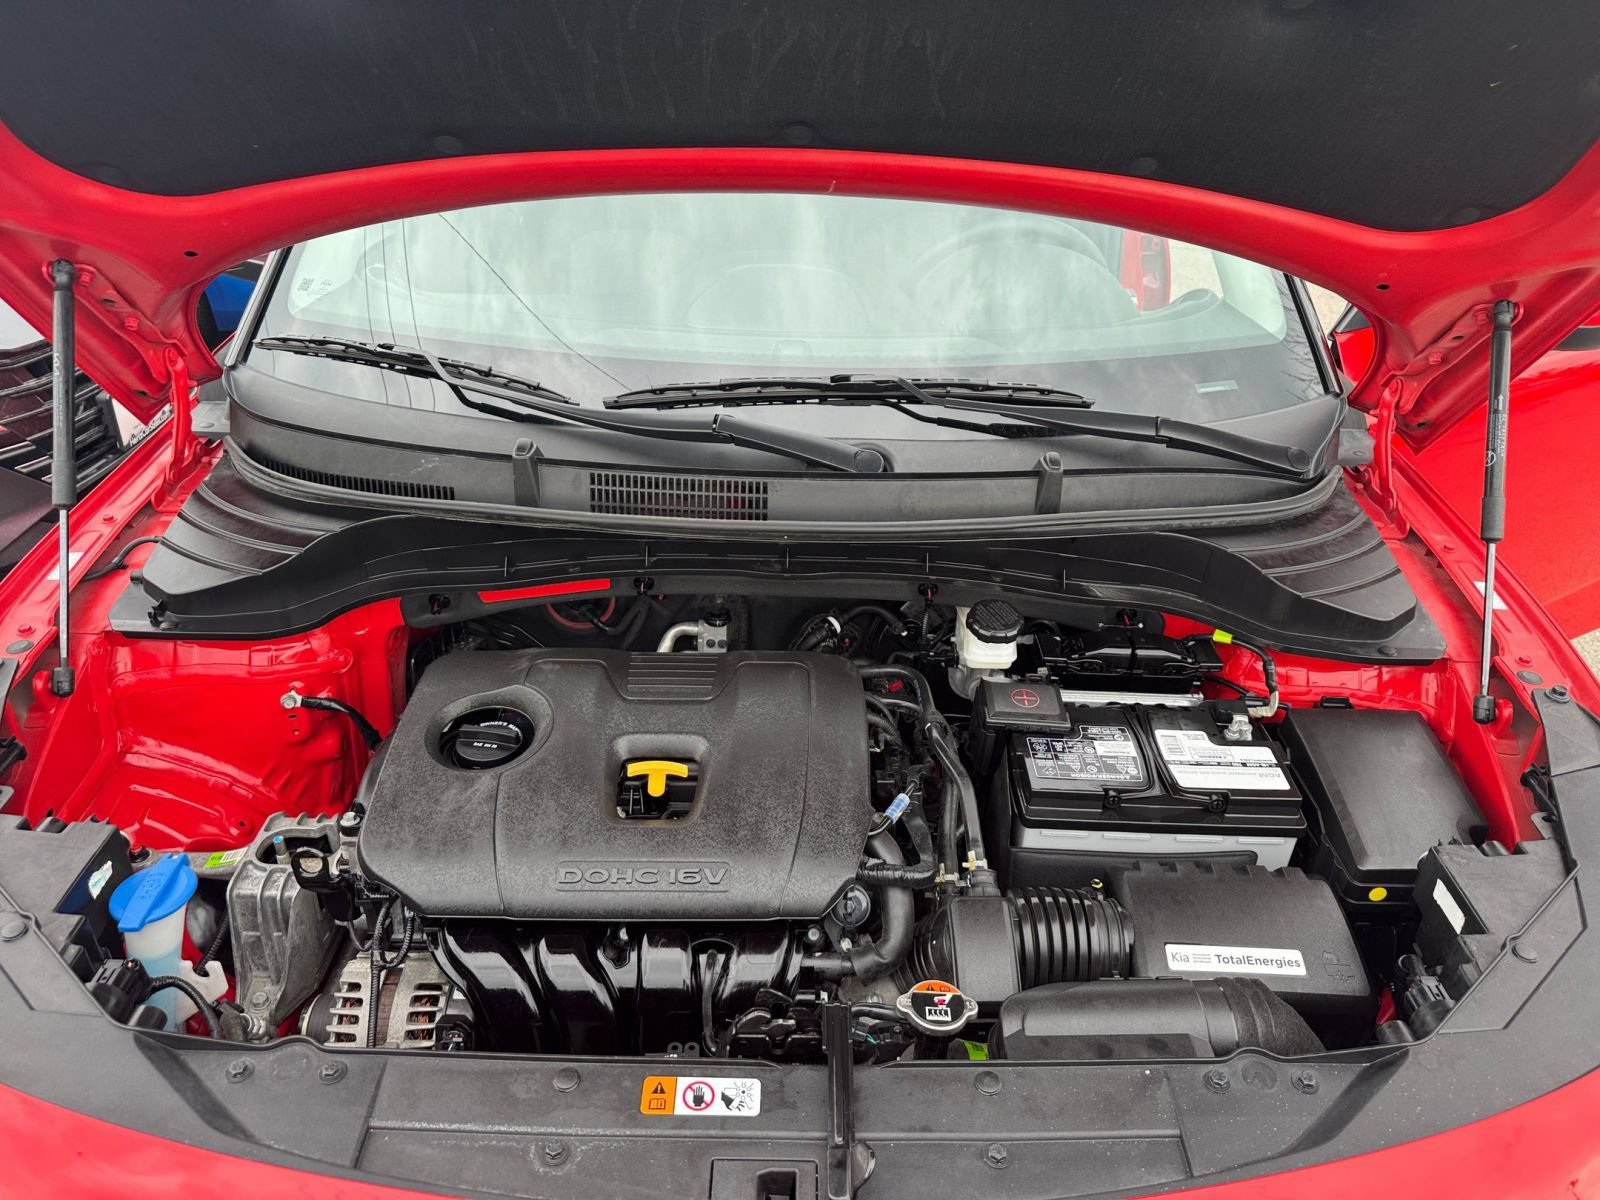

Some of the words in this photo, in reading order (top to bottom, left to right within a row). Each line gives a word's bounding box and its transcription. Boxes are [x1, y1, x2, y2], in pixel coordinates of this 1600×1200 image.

[558, 867, 658, 884] DOHC
[668, 867, 728, 884] 16V
[1171, 952, 1190, 963] Kia
[1215, 954, 1301, 968] TotalEnergies
